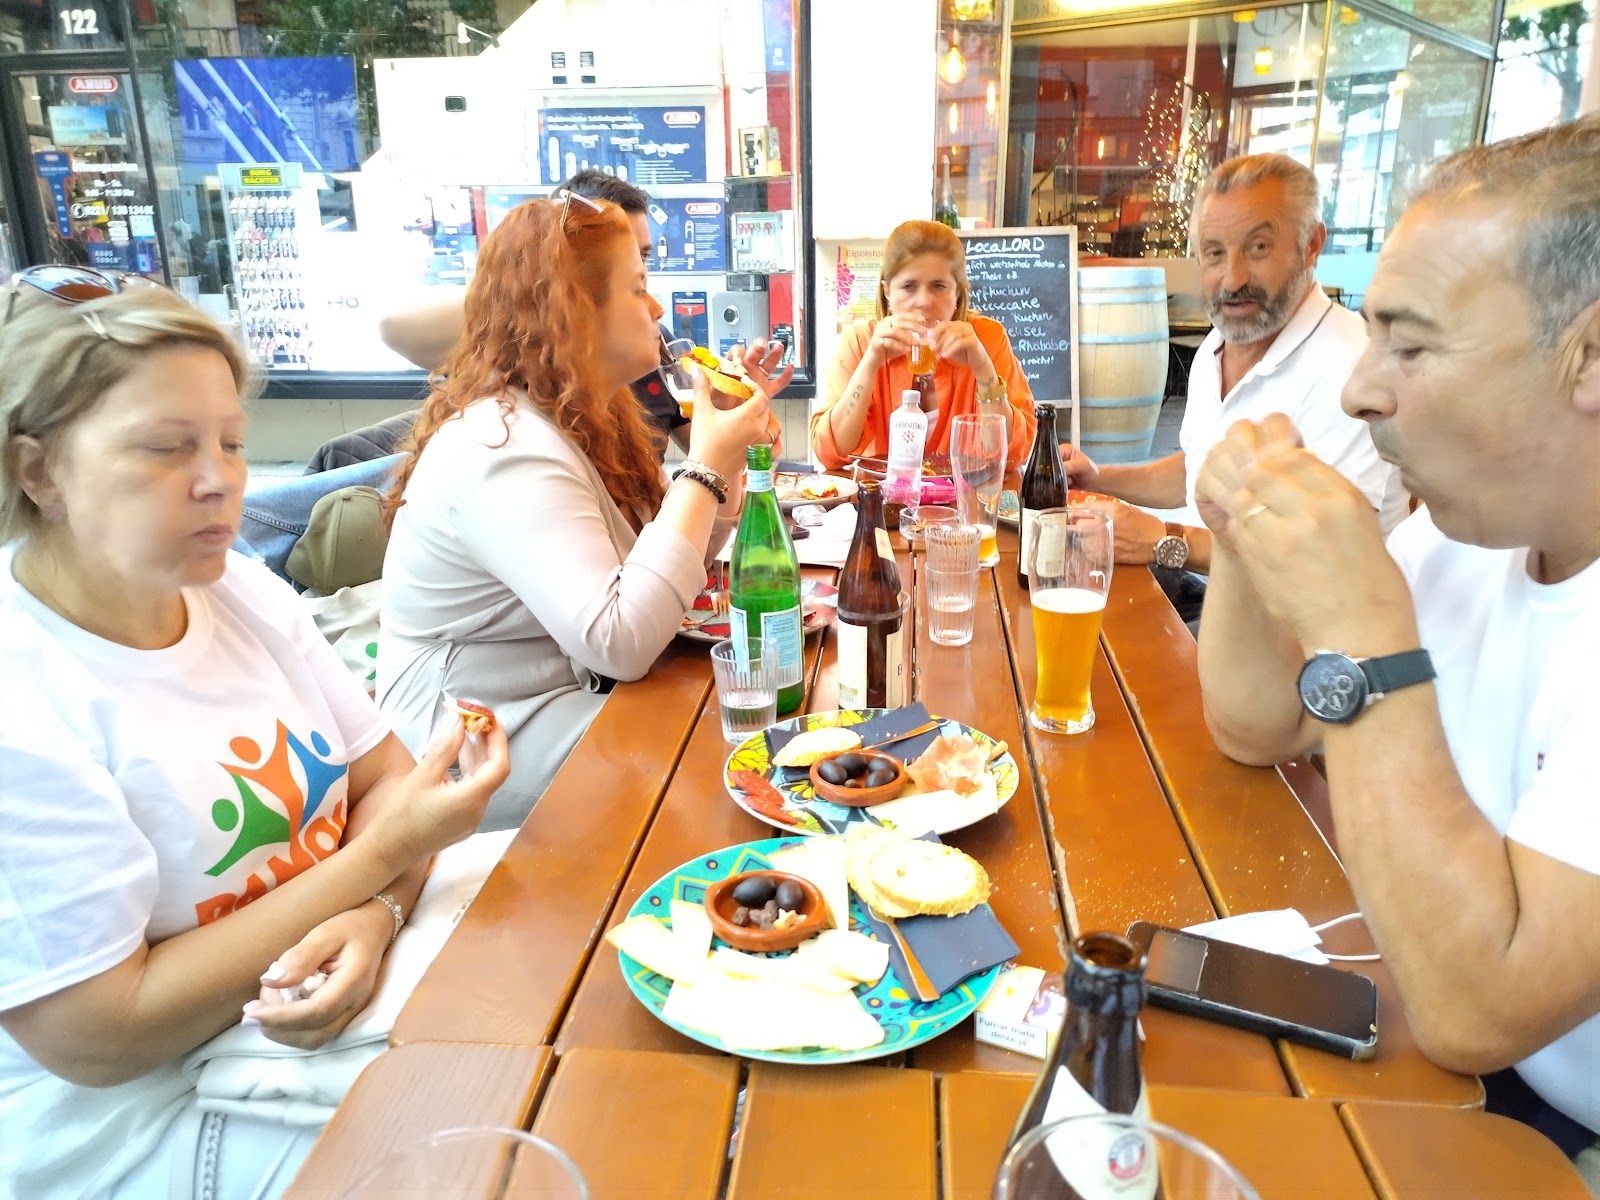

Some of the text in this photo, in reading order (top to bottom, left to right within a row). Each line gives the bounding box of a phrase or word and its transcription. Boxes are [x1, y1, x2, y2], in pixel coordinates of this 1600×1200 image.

[61, 9, 99, 34] 122
[968, 285, 1030, 302] upfkuchen
[978, 1016, 1036, 1039] Fumar mata
